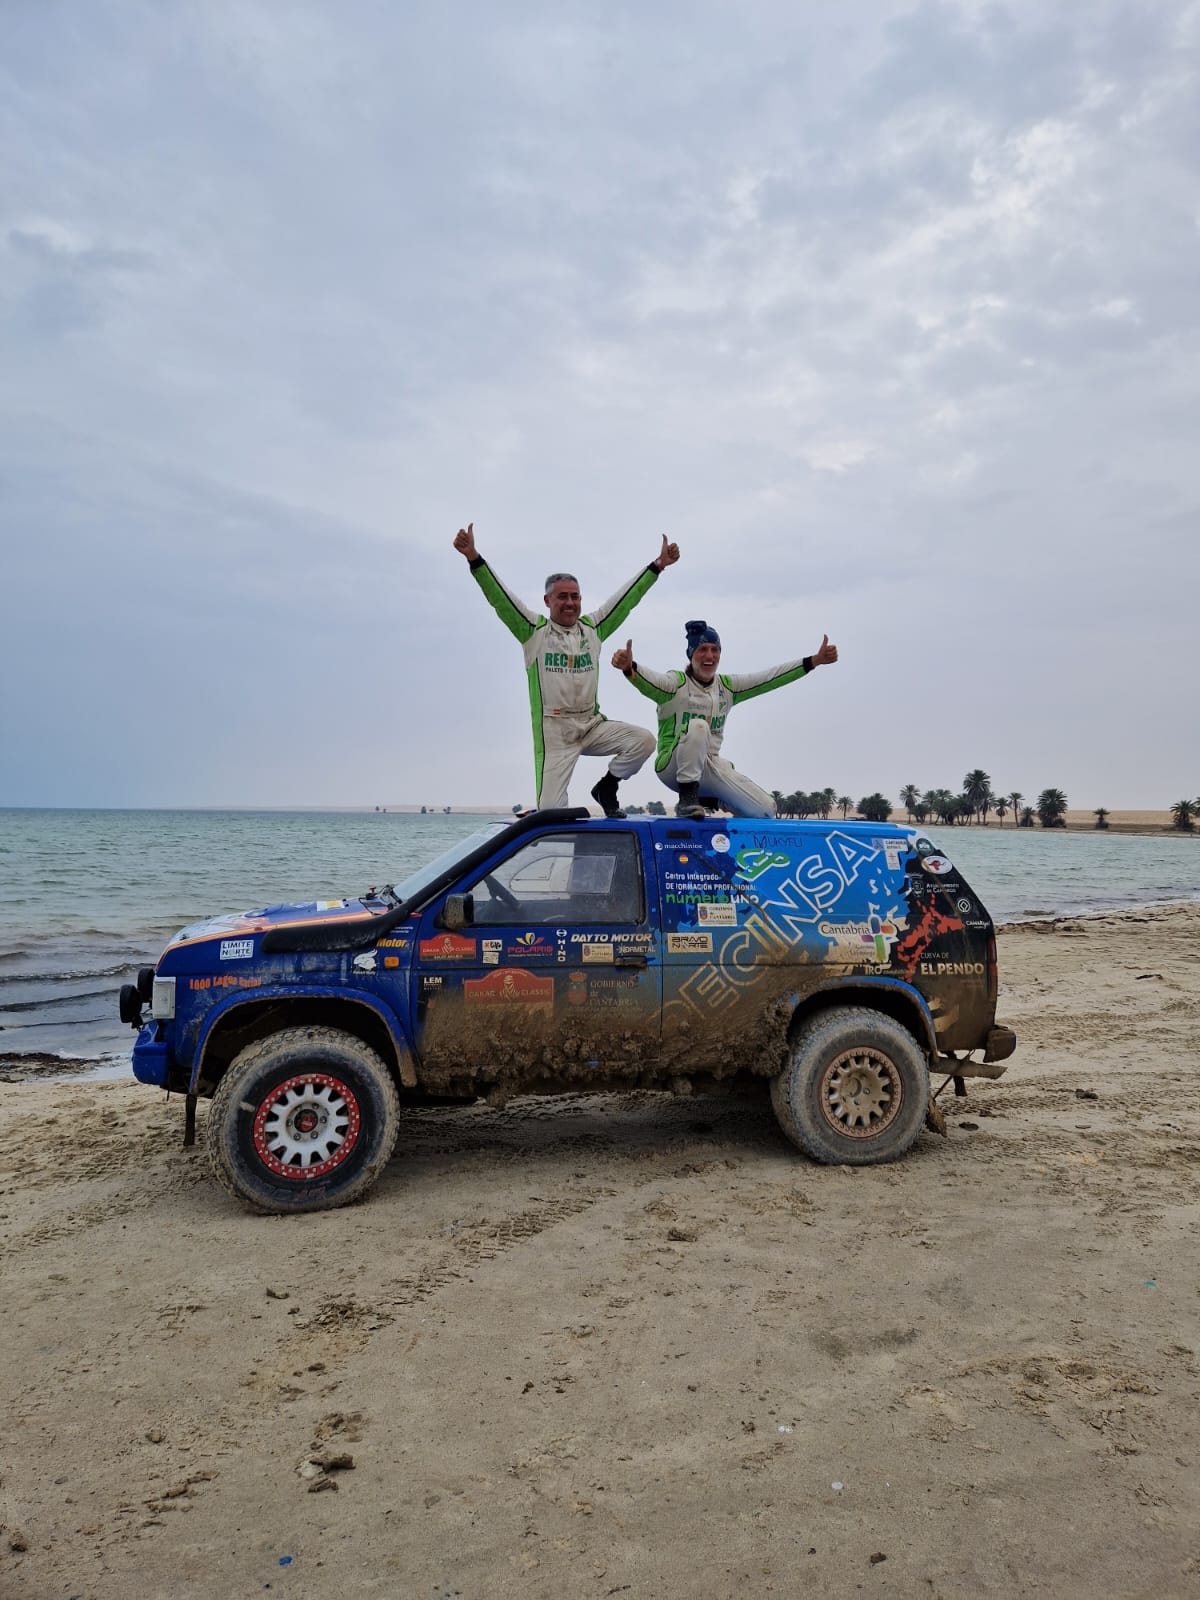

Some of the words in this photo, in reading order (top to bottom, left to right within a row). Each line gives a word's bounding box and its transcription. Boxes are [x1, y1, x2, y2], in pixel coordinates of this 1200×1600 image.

[545, 652, 593, 668] RECINSA
[687, 872, 719, 881] Integrado
[713, 883, 756, 891] PROFEIONAL
[645, 831, 880, 1023] ECINSA
[820, 924, 870, 935] Cantabria
[611, 933, 652, 942] MOTOR
[222, 941, 251, 949] LIMITE
[557, 939, 566, 962] HINO
[921, 963, 936, 975] EL
[939, 963, 985, 975] PENDO
